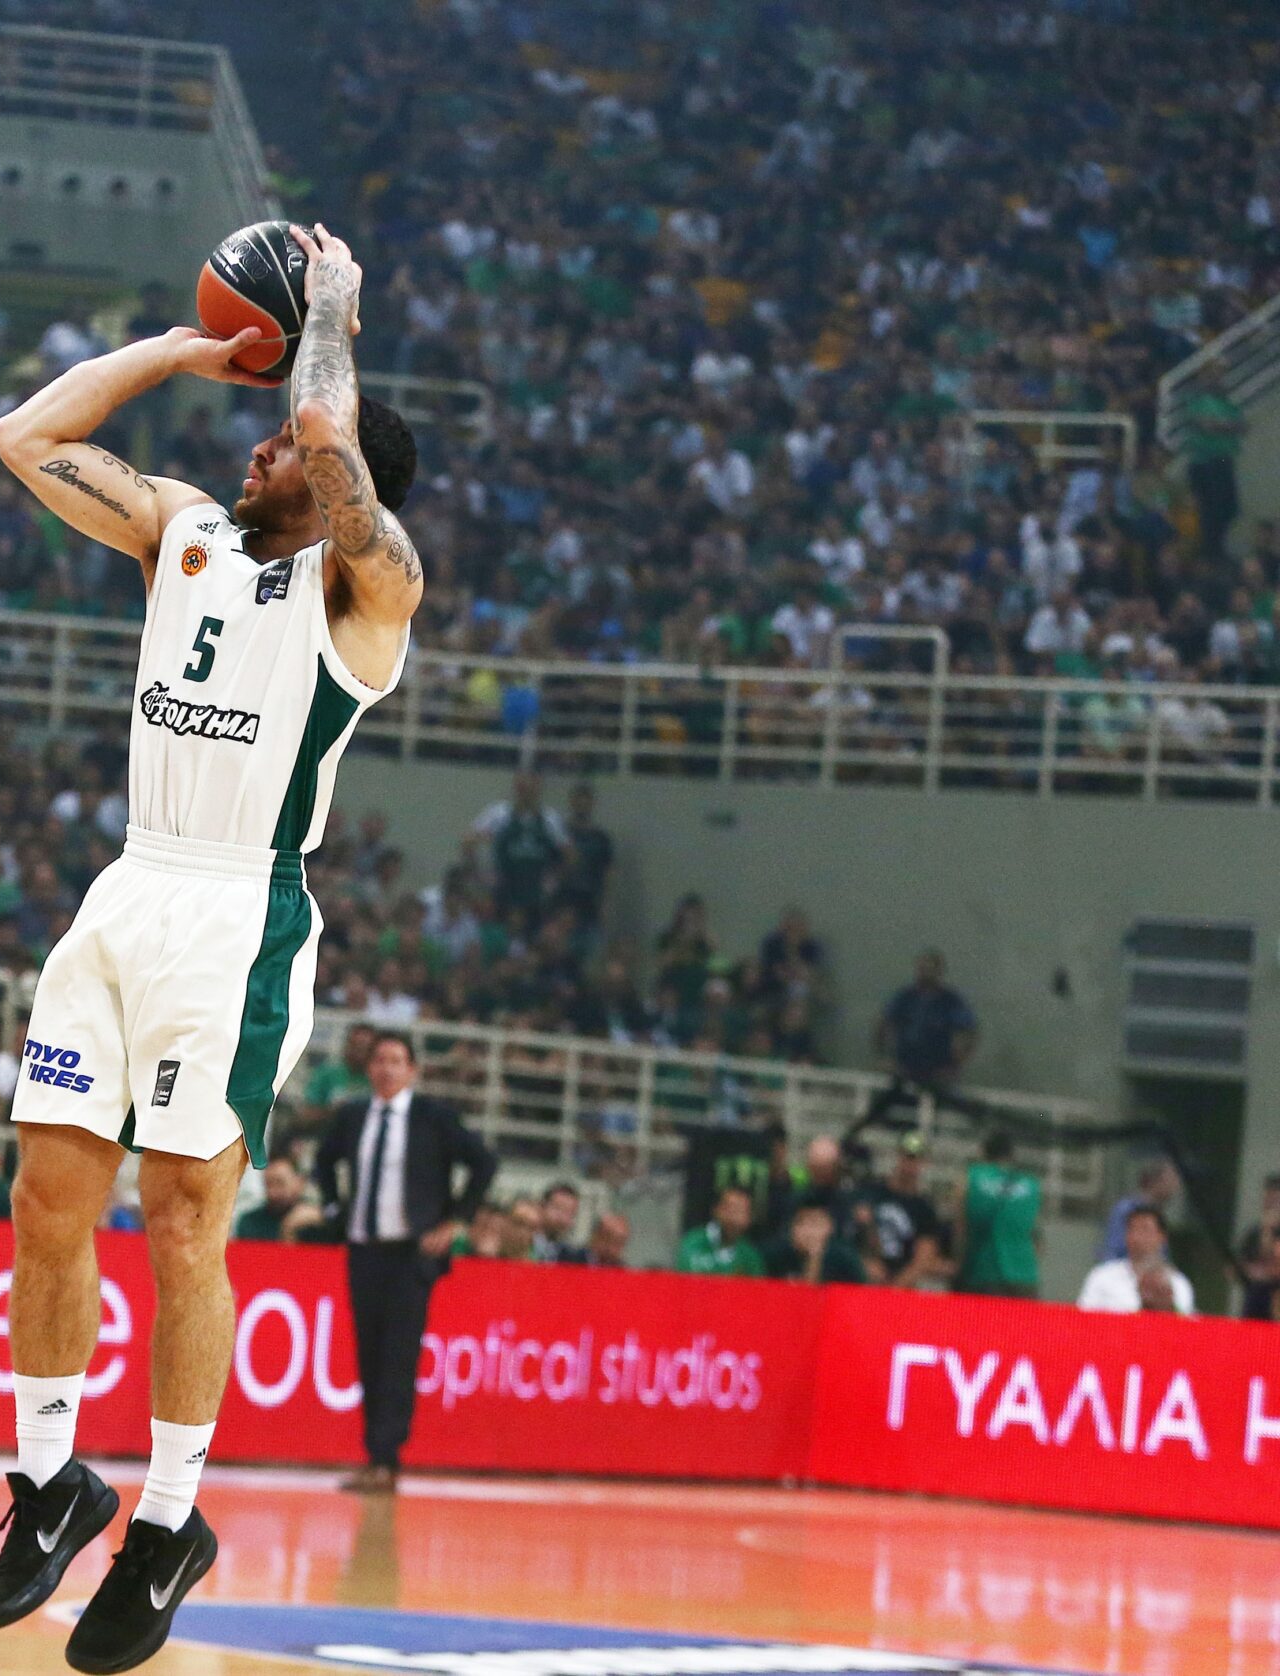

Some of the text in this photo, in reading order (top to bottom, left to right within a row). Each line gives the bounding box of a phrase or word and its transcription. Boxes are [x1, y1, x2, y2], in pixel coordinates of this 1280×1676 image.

[183, 615, 225, 683] 5
[27, 1062, 95, 1093] IRES
[235, 1289, 364, 1410] ou
[598, 1328, 762, 1411] studios
[886, 1342, 1210, 1461] ΓΥΑΛΙΑ
